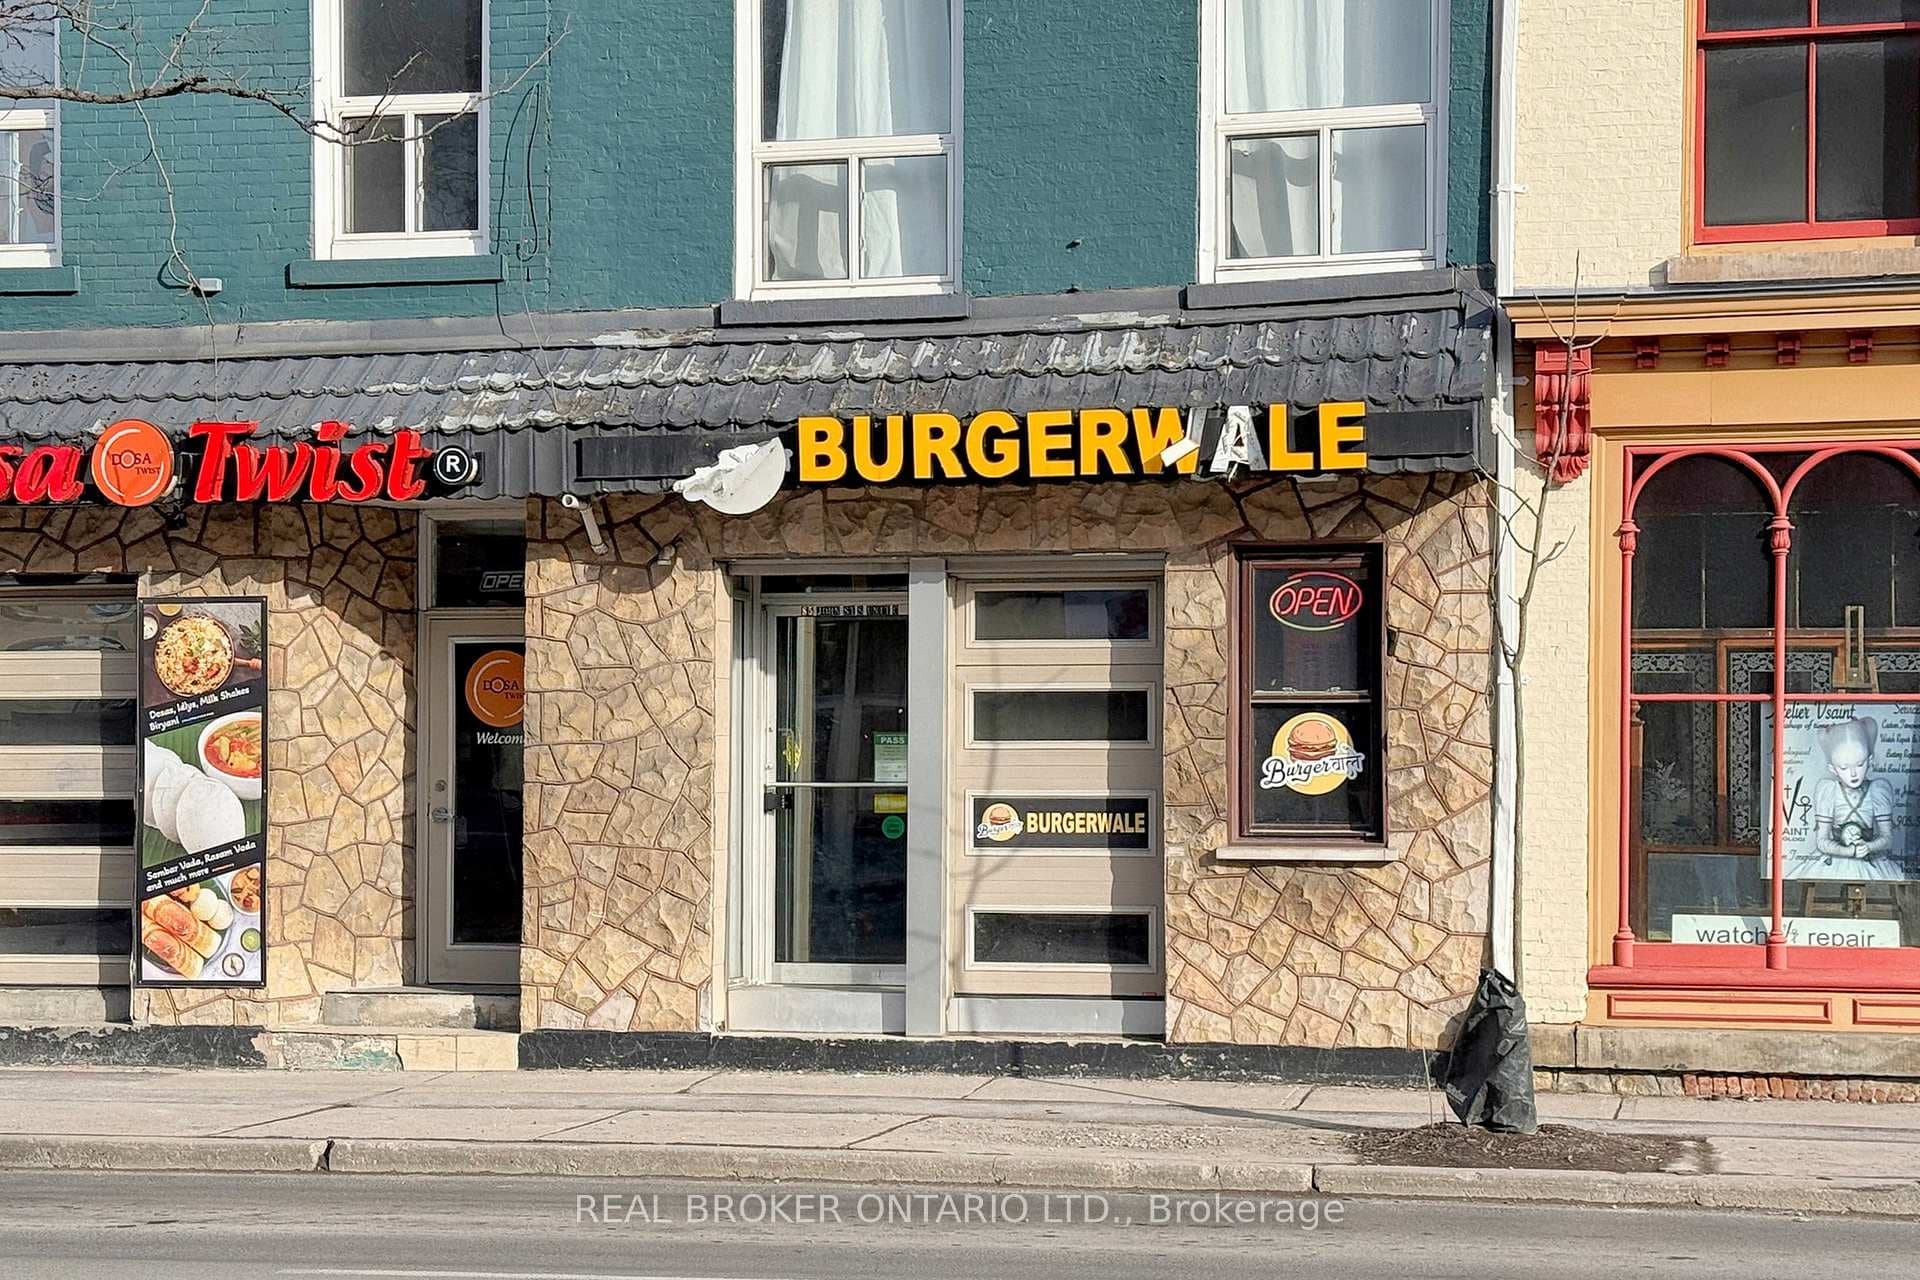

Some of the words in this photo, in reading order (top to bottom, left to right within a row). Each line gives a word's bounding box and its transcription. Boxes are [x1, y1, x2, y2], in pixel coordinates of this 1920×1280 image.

[798, 401, 1368, 483] BURGERWALE
[112, 450, 152, 469] DOSA
[189, 420, 431, 503] Twist
[134, 466, 161, 475] TWIST
[482, 574, 524, 589] OPE
[1274, 587, 1354, 616] OPEN
[483, 677, 519, 693] DOSA
[200, 694, 219, 706] Milk
[220, 687, 250, 701] Shakes
[504, 691, 525, 700] TWIS
[149, 716, 180, 732] Biryani
[476, 731, 524, 745] Welcom
[880, 736, 905, 744] PASS
[1026, 812, 1146, 834] BURGERWALE
[146, 865, 178, 881] Sambar
[204, 849, 233, 862] Rasam
[146, 882, 163, 892] and
[164, 873, 187, 887] much
[189, 867, 209, 879] more
[1696, 926, 1768, 945] watch
[1808, 929, 1875, 947] repair
